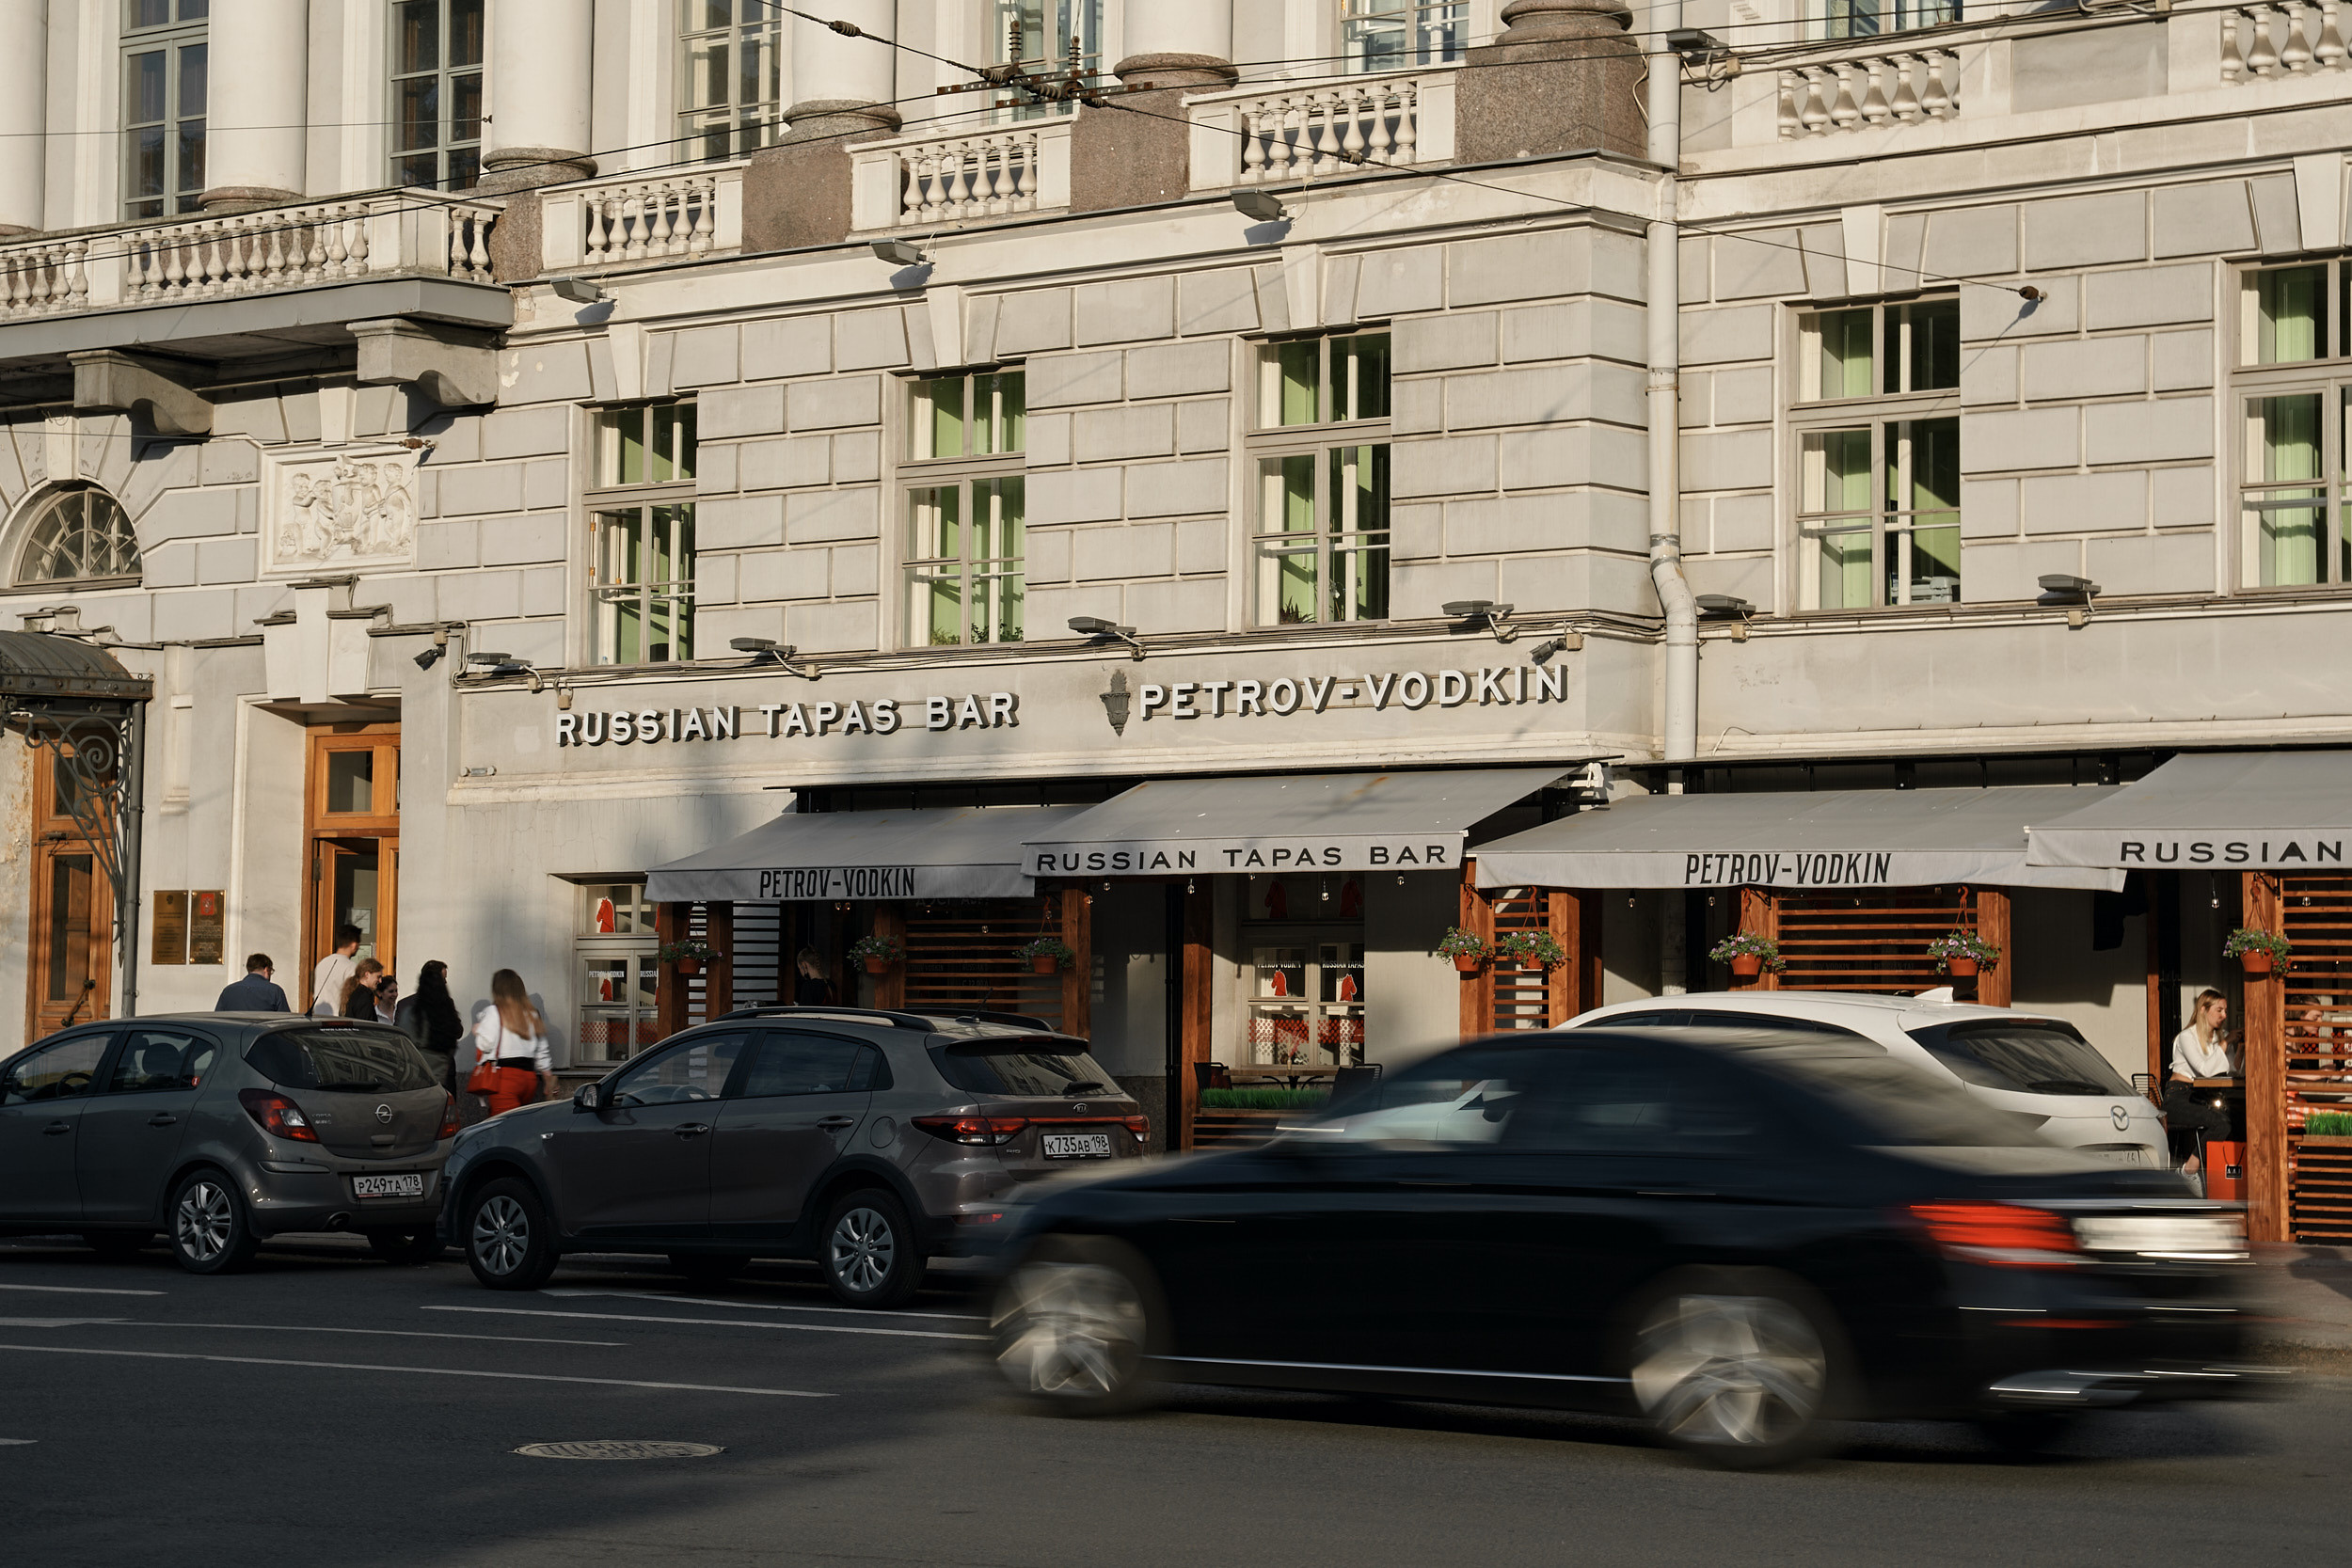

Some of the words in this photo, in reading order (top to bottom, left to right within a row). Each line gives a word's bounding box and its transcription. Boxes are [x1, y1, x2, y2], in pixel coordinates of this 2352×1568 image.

[1139, 664, 1567, 720] PETROV-VODKIN
[556, 705, 739, 745] RUSSIAN
[759, 699, 900, 736] TAPAS
[927, 692, 1018, 730] BAR
[1037, 850, 1196, 871] RUSSIAN
[1222, 847, 1342, 867] TAPAS
[1370, 845, 1446, 865] BAR
[2120, 841, 2342, 863] RUSSIAN
[759, 867, 916, 898] PETROV-VODKIN
[1684, 852, 1893, 885] PETROV-VODKIN
[1322, 959, 1346, 969] RUSSIAN
[403, 1175, 420, 1187] 178
